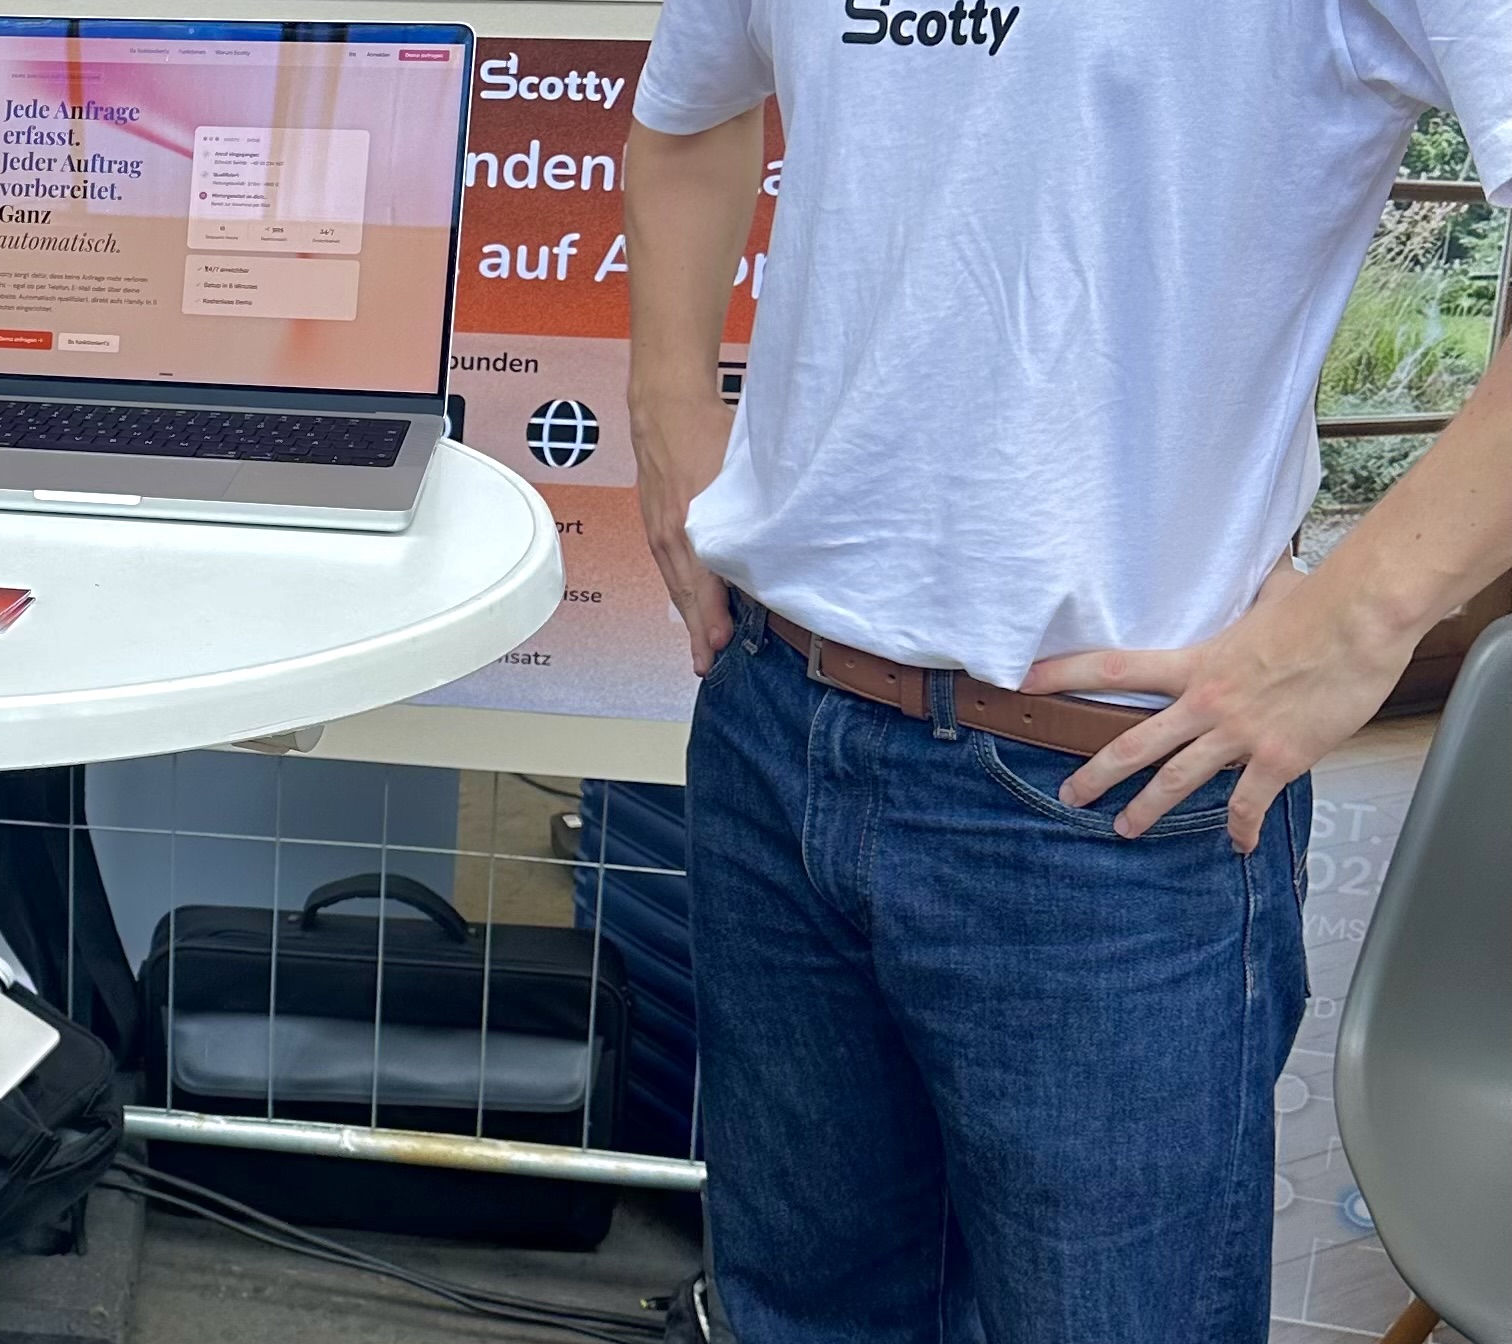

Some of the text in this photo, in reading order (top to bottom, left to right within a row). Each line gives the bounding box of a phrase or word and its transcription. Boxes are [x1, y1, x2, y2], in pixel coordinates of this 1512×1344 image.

[480, 52, 625, 109] Scotty
[3, 99, 140, 126] Jede Anfrage
[3, 125, 81, 147] erfasst.
[0, 152, 143, 179] Jeder Auftrag
[0, 178, 123, 201] vorbereitet.
[478, 232, 580, 281] auf
